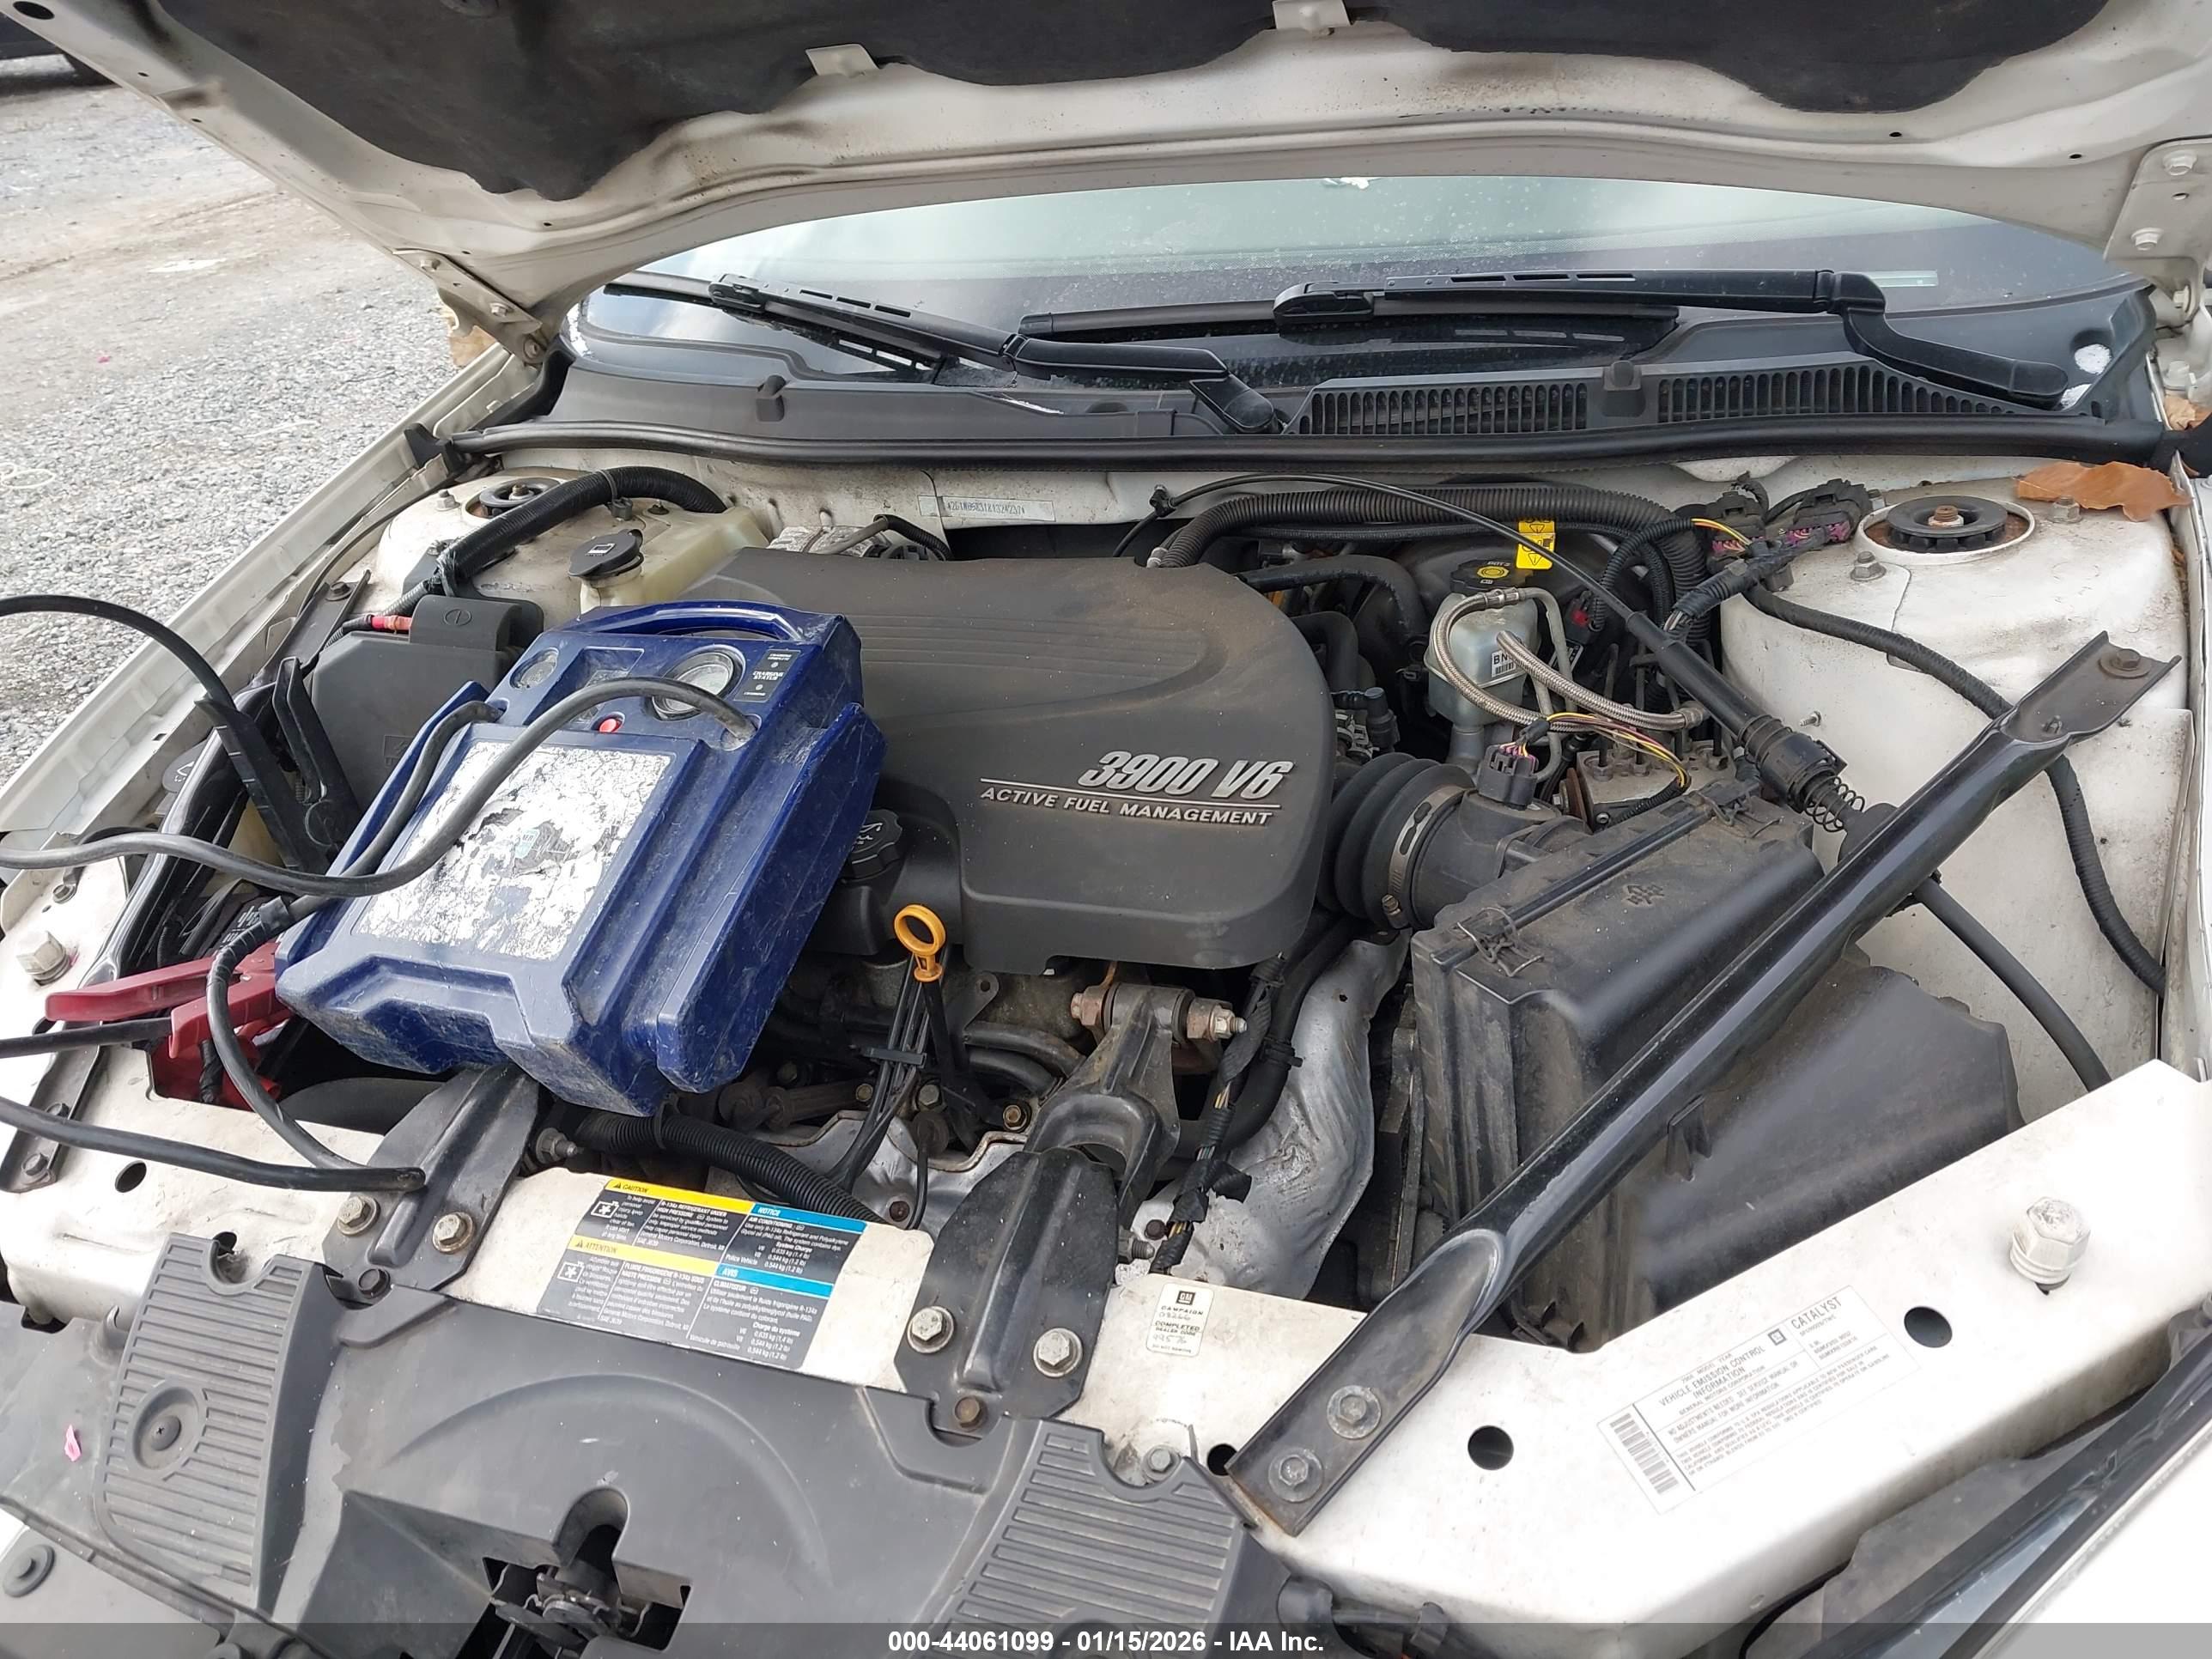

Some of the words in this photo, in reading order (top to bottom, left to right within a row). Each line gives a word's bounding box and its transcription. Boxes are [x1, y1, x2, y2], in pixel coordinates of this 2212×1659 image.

[1078, 750, 1218, 795] 3900
[1211, 760, 1293, 799] V6
[981, 787, 1058, 808] ACTIVE
[1063, 797, 1110, 814] FUEL
[1119, 804, 1273, 825] MANAGEMENT
[623, 1184, 648, 1193] CAUTION
[758, 1207, 781, 1216] NOTICE
[758, 1218, 793, 1228] CONDITIONING
[585, 1242, 618, 1254] ATTENTION
[721, 1268, 739, 1279] AVIS
[1791, 1297, 1841, 1328] CATALYST
[1155, 1321, 1200, 1332] COMPLETED
[1660, 1385, 1691, 1406] VEHICLE
[1692, 1365, 1729, 1388] EMISSION
[1729, 1346, 1764, 1367] CONTROL
[1693, 1367, 1745, 1398] INFORMATION
